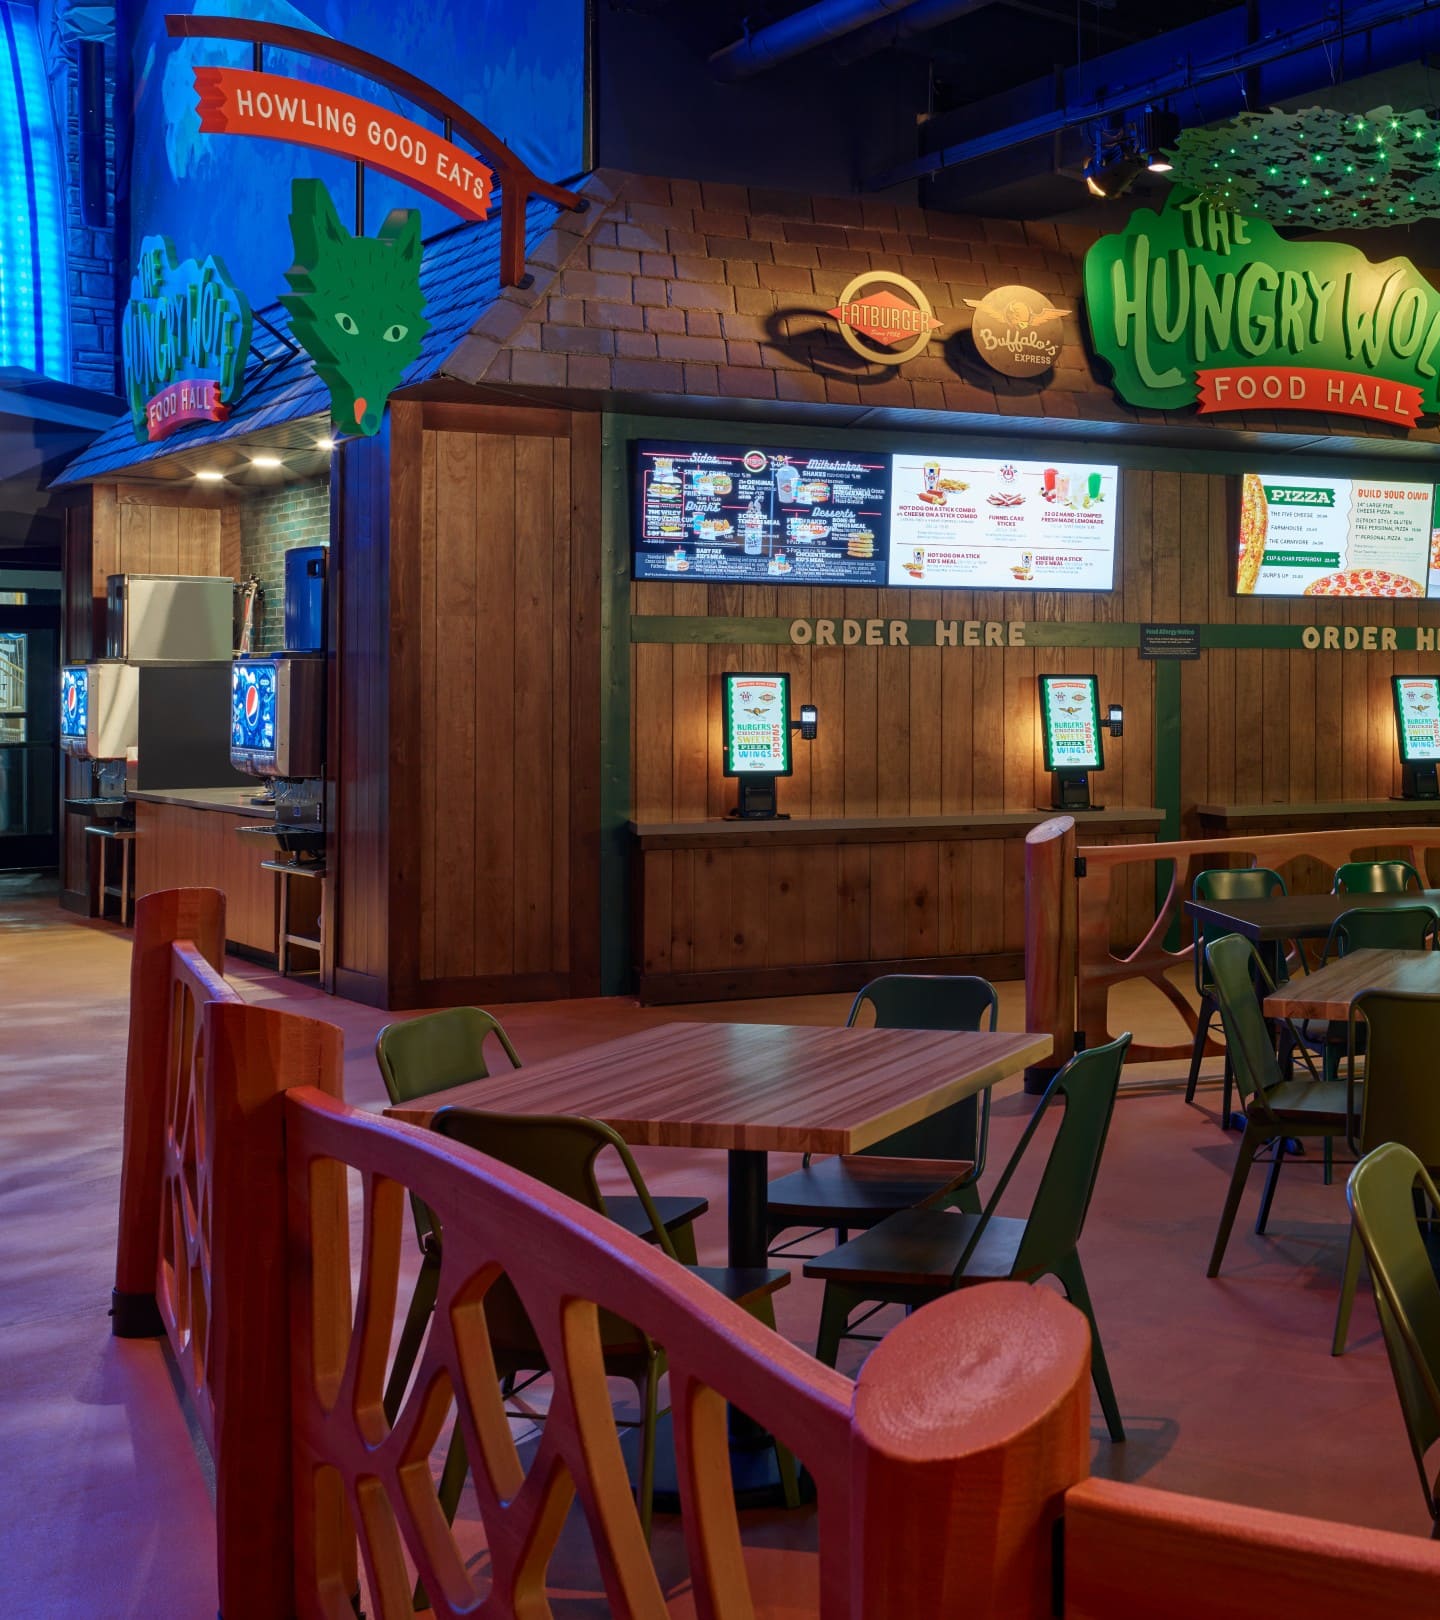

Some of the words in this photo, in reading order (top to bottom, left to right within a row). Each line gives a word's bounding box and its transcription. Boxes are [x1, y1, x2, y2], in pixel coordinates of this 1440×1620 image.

[236, 88, 357, 137] HOWLING
[367, 121, 427, 166] GOOD
[436, 153, 485, 200] EATS
[1179, 196, 1252, 255] THE
[140, 249, 163, 299] THE
[840, 302, 930, 333] FATBURGER
[1112, 234, 1336, 388] HUNGRY
[123, 295, 187, 427] HUNGRY
[186, 268, 239, 388] WOLF
[979, 328, 1058, 356] Buffalo's
[1014, 353, 1052, 365] EXPRESS
[150, 392, 177, 427] FOOD
[181, 386, 211, 411] HALL
[1215, 375, 1306, 401] FOOD
[1327, 379, 1409, 415] HALL
[1271, 489, 1331, 503] PIZZA
[1358, 489, 1382, 498] BUILD
[1384, 490, 1405, 500] YOUR
[1407, 491, 1429, 501] OWN
[789, 619, 910, 646] ORDER
[935, 620, 1026, 647] HERE
[1302, 626, 1398, 650] ORDER
[738, 750, 771, 758] WINGS
[772, 724, 780, 758] SNACKS
